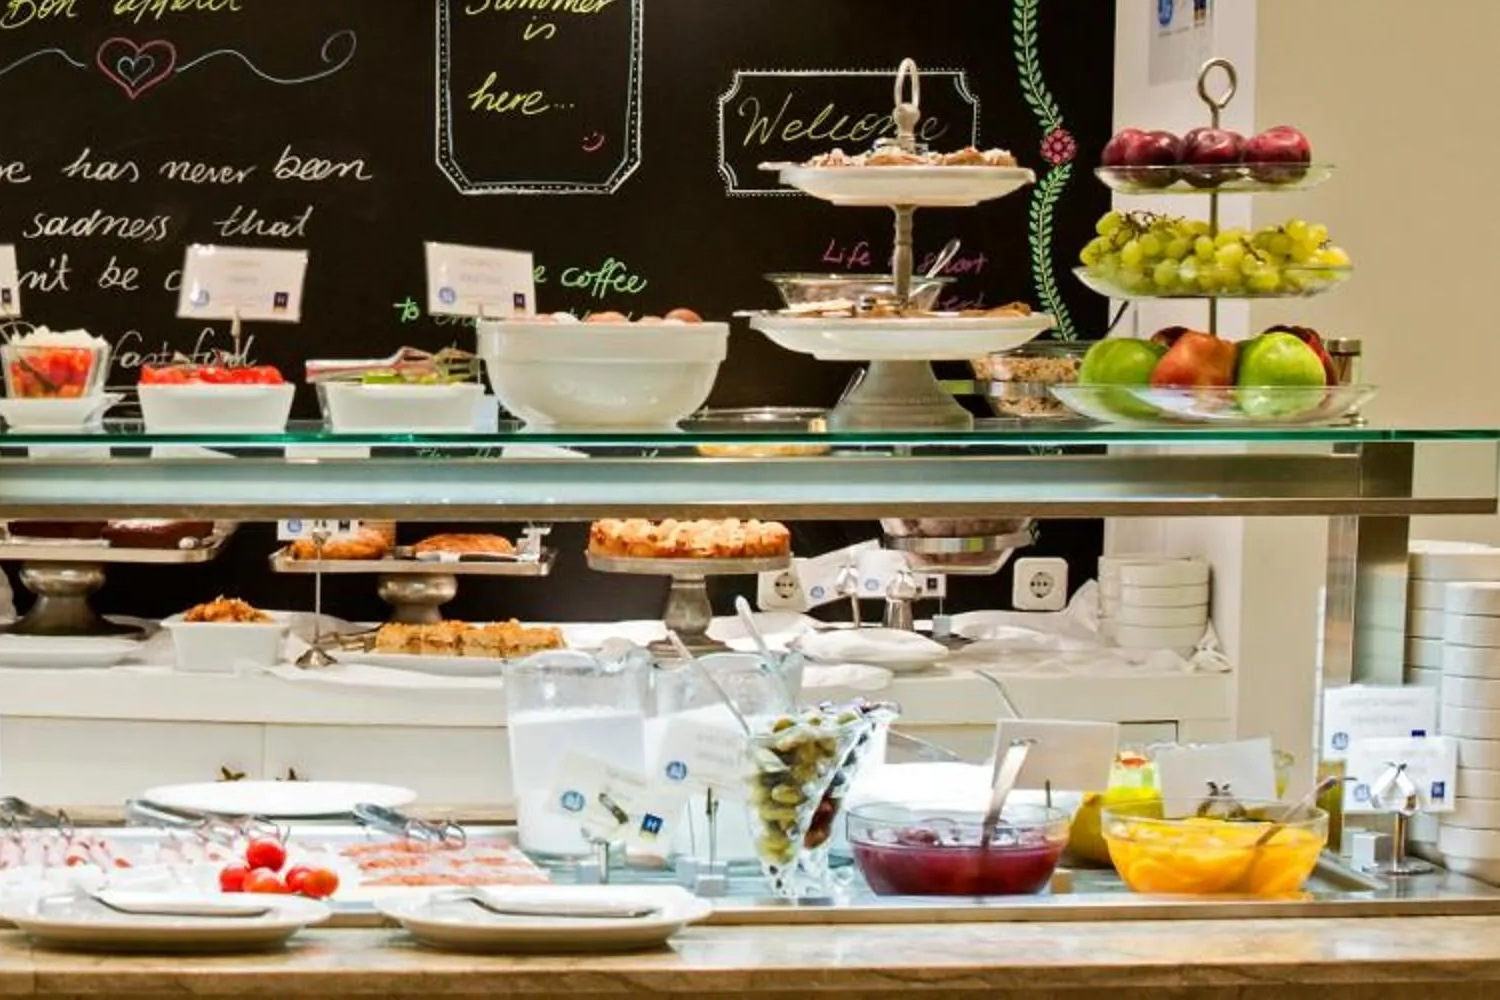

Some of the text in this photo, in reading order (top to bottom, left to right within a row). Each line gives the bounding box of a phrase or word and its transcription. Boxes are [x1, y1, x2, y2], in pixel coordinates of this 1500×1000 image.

[525, 16, 556, 39] is
[62, 149, 139, 181] has
[161, 162, 255, 182] never
[275, 146, 372, 180] been
[24, 211, 170, 241] sadness
[215, 206, 312, 237] that
[823, 239, 871, 268] Life
[19, 254, 71, 291] n't
[100, 258, 139, 289] be
[562, 258, 648, 298] coffee
[394, 298, 419, 321] to
